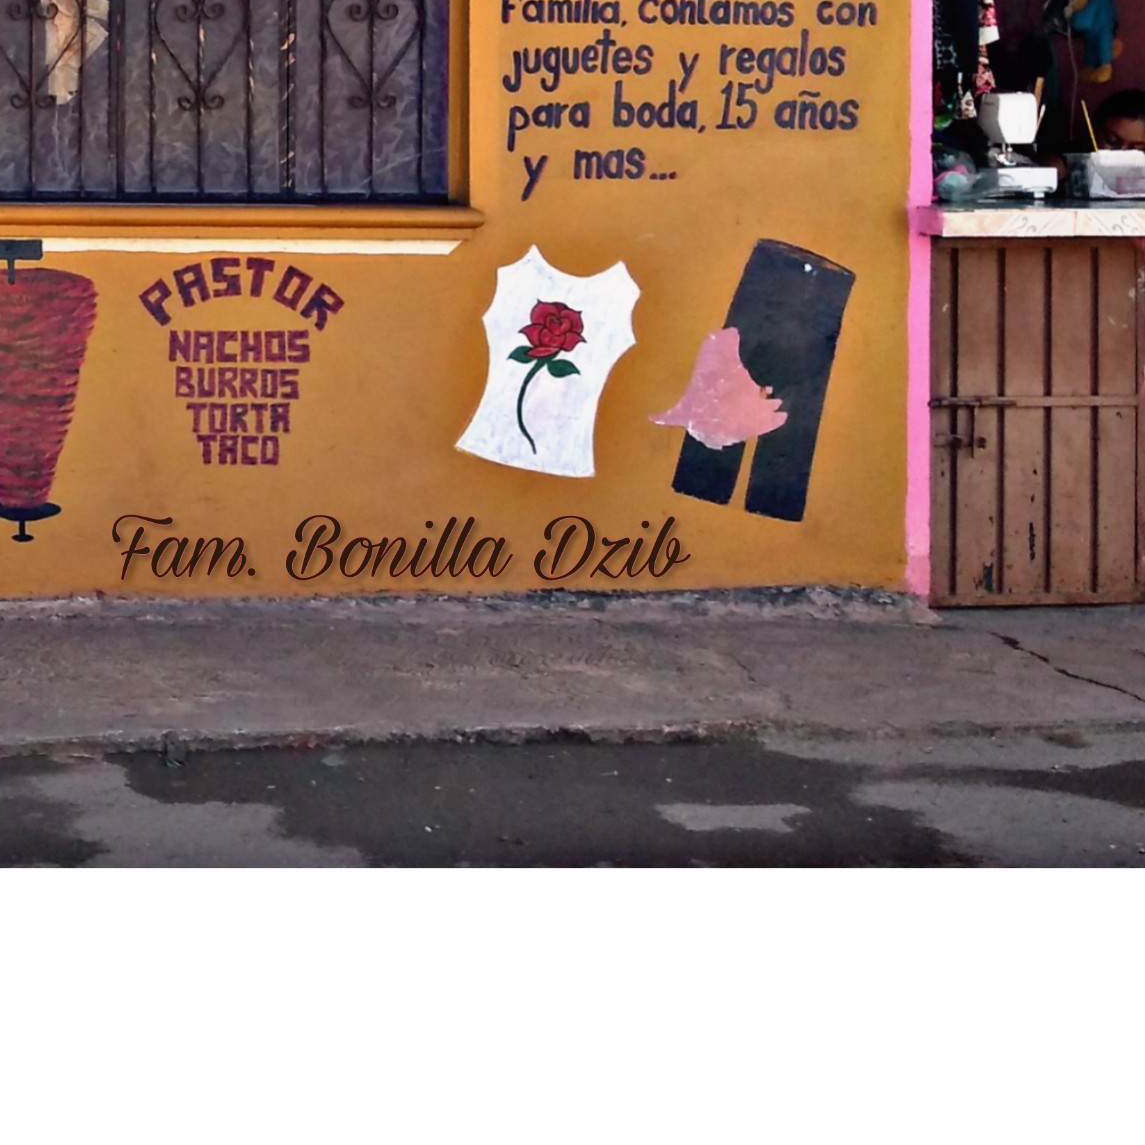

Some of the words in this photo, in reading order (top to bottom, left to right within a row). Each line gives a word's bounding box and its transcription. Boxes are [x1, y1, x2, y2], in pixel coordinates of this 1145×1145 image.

[816, 0, 878, 27] con
[502, 28, 654, 93] juguetes
[677, 52, 700, 93] y
[719, 28, 847, 94] regalos
[506, 102, 591, 153] para
[612, 79, 706, 134] boda,
[715, 79, 758, 130] 15
[773, 89, 860, 131] años
[521, 154, 549, 203] y
[573, 147, 678, 181] mas...
[139, 256, 345, 331] PASTOR
[168, 329, 311, 364] NACHOS
[175, 365, 301, 400] BURROS
[185, 402, 291, 434] TORTA
[196, 434, 280, 466] TACO
